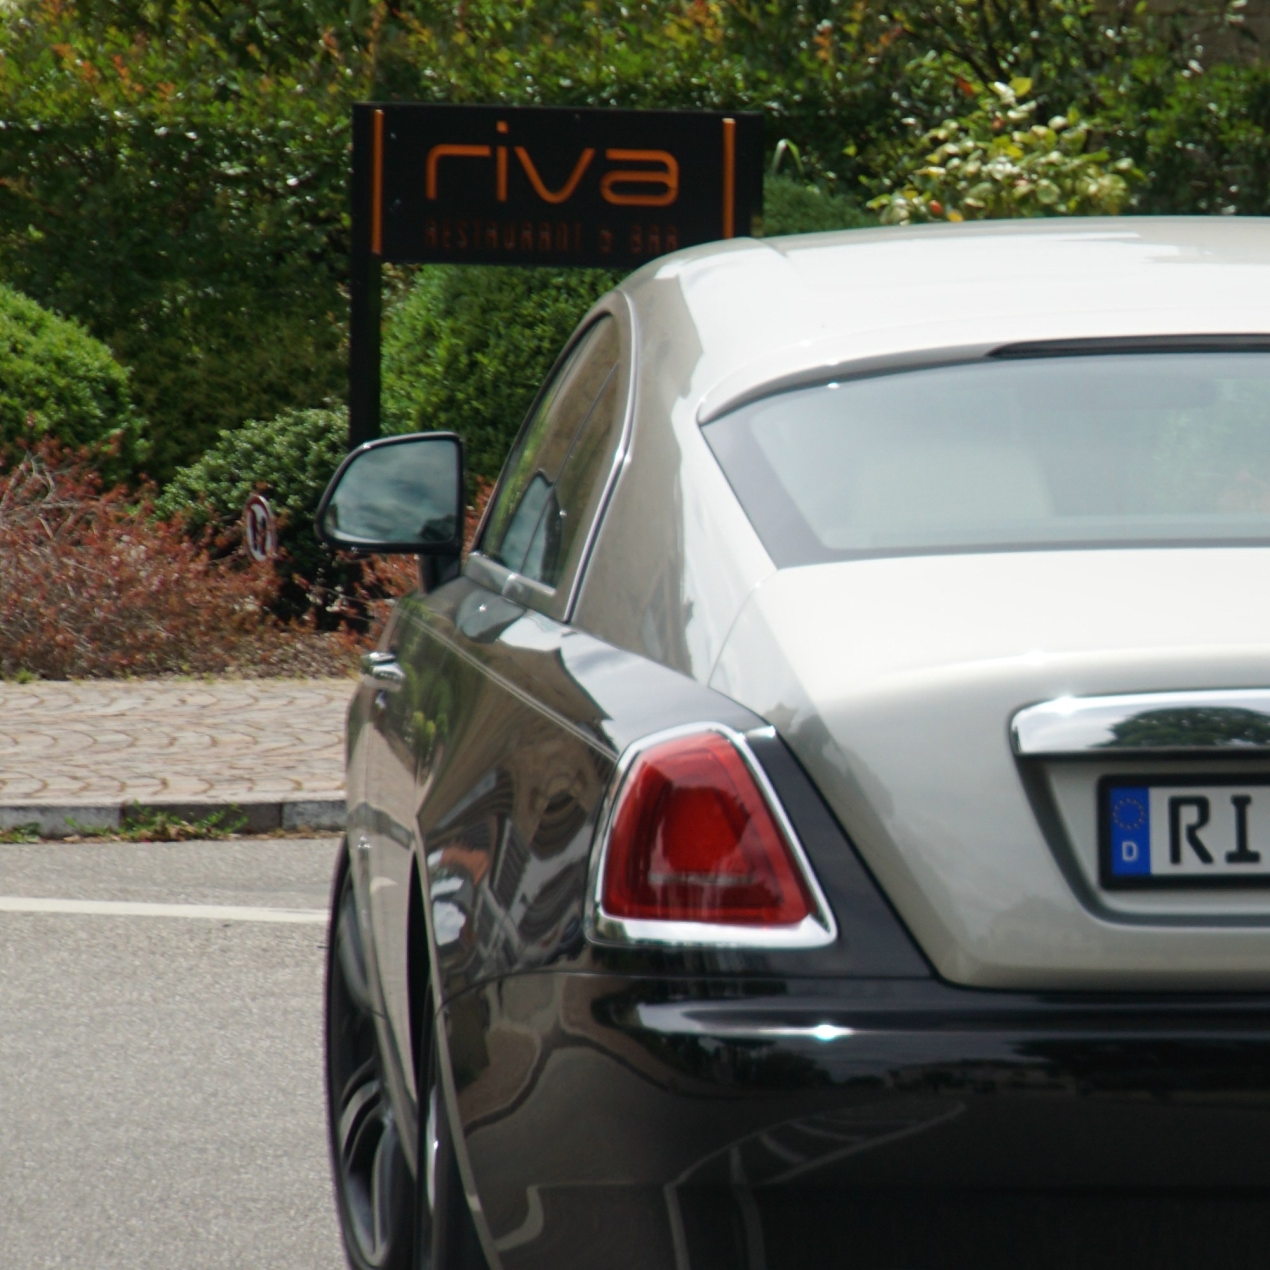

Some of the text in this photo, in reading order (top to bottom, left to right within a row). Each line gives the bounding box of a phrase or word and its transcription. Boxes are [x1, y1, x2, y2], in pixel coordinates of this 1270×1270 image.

[425, 120, 680, 206] riva
[1121, 840, 1138, 862] D
[1168, 794, 1261, 864] RI
